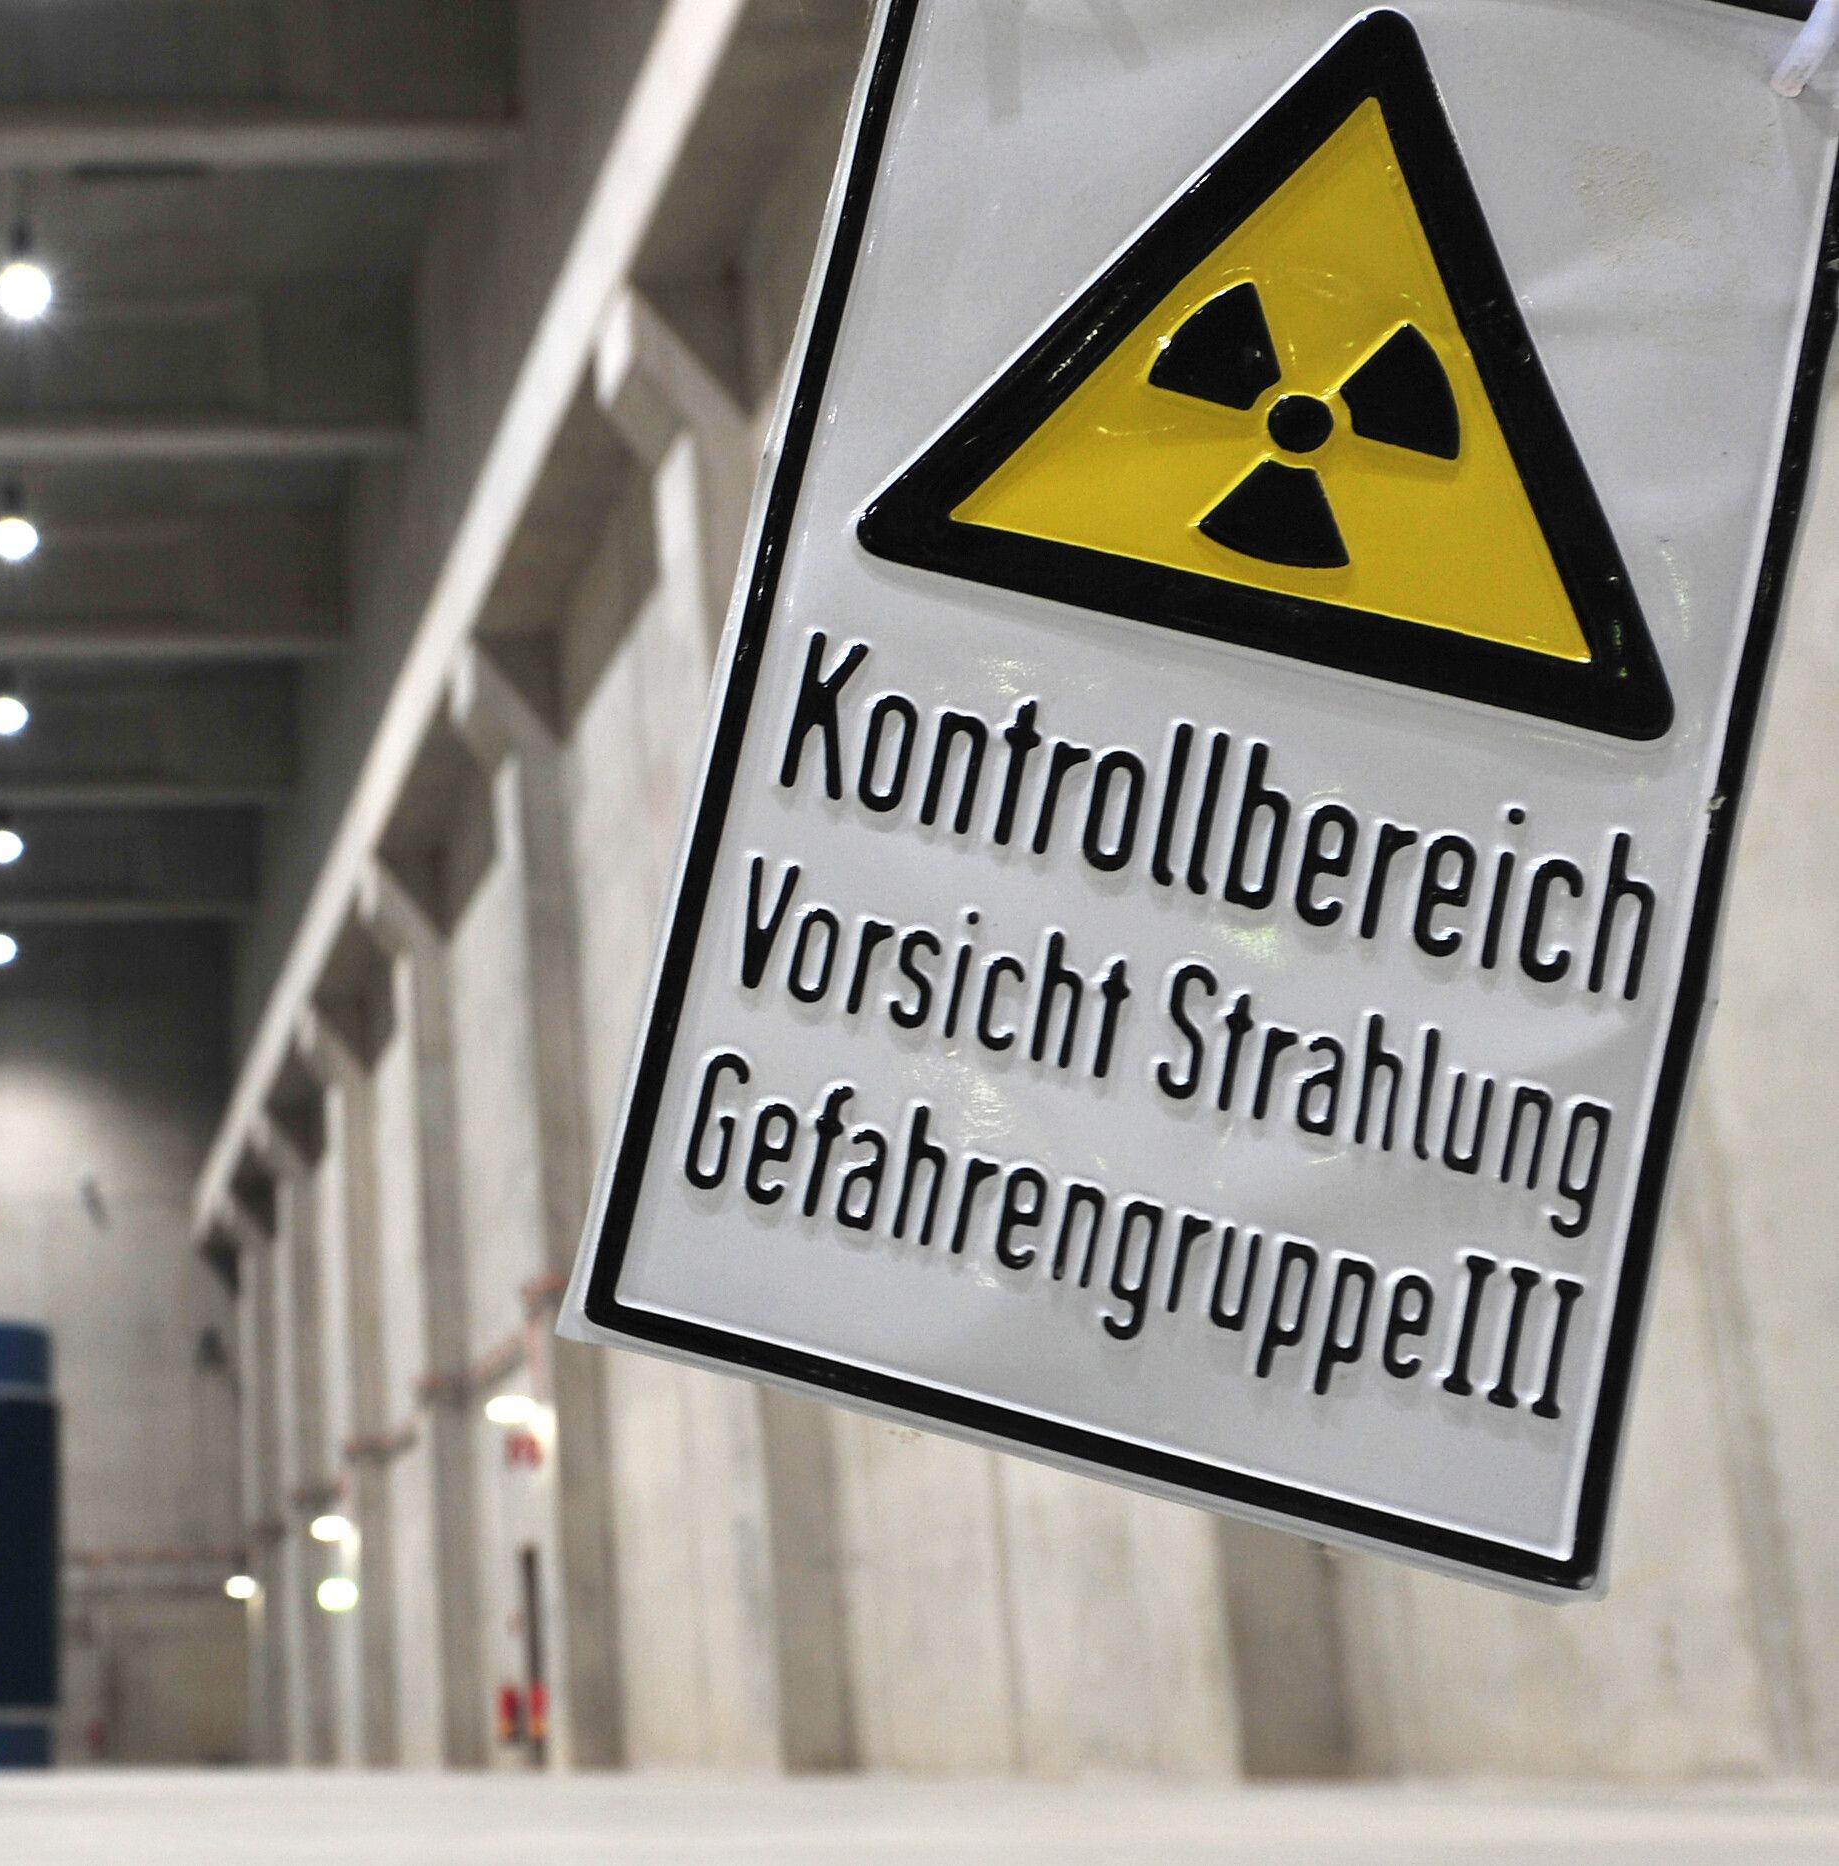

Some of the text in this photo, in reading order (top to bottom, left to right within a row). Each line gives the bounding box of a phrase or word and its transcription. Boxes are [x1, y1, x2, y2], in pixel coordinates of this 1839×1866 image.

[778, 630, 1658, 1002] Kontrollbereich
[741, 856, 1612, 1240] Vorsicht Strahlung
